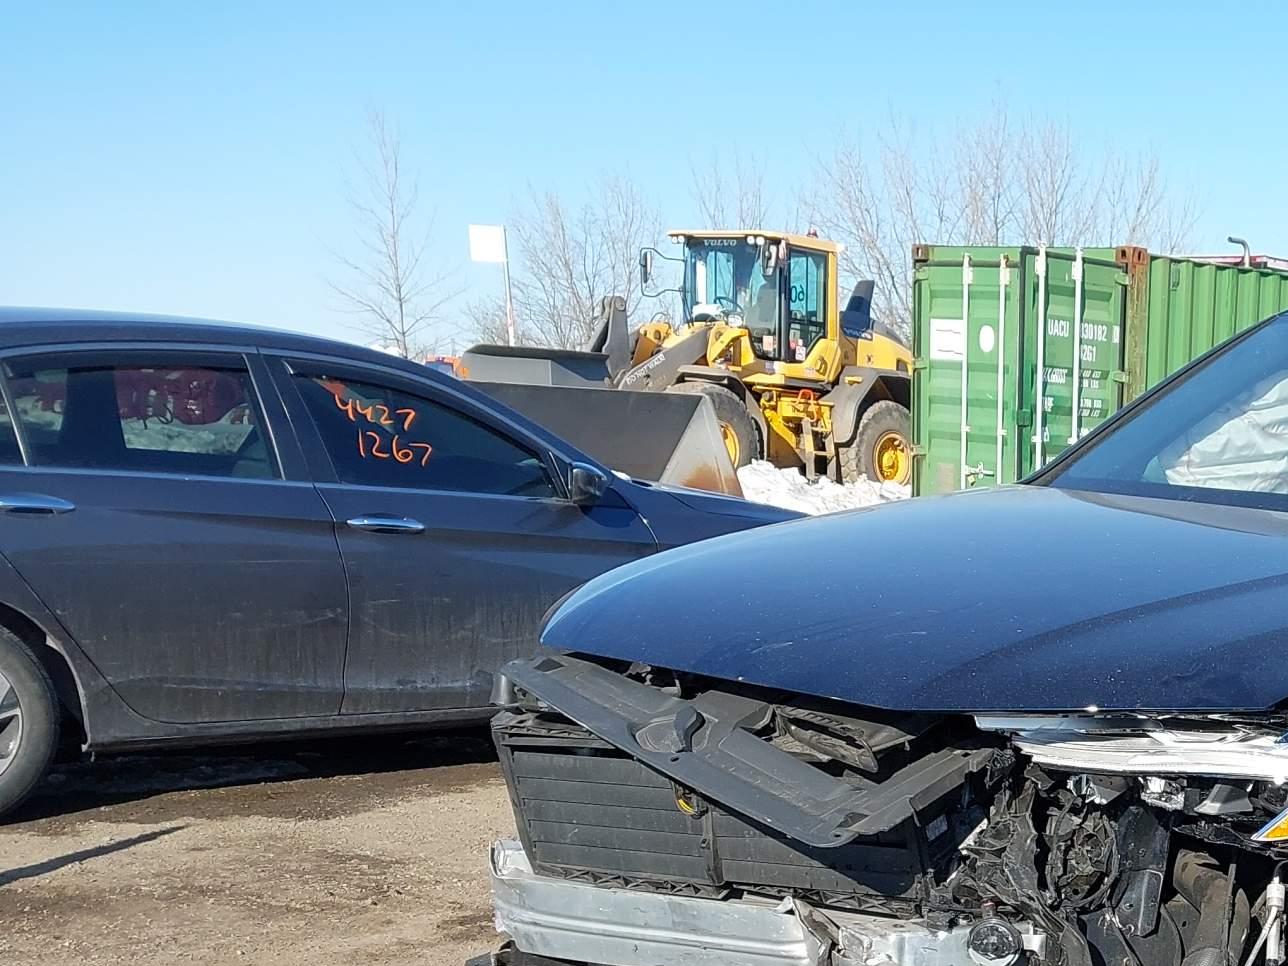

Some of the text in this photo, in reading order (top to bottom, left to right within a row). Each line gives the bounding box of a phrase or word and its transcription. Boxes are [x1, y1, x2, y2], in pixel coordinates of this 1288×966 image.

[704, 239, 737, 247] VOLVO
[1048, 319, 1069, 337] UACU
[335, 394, 416, 431] 4427
[358, 427, 432, 467] 1267
